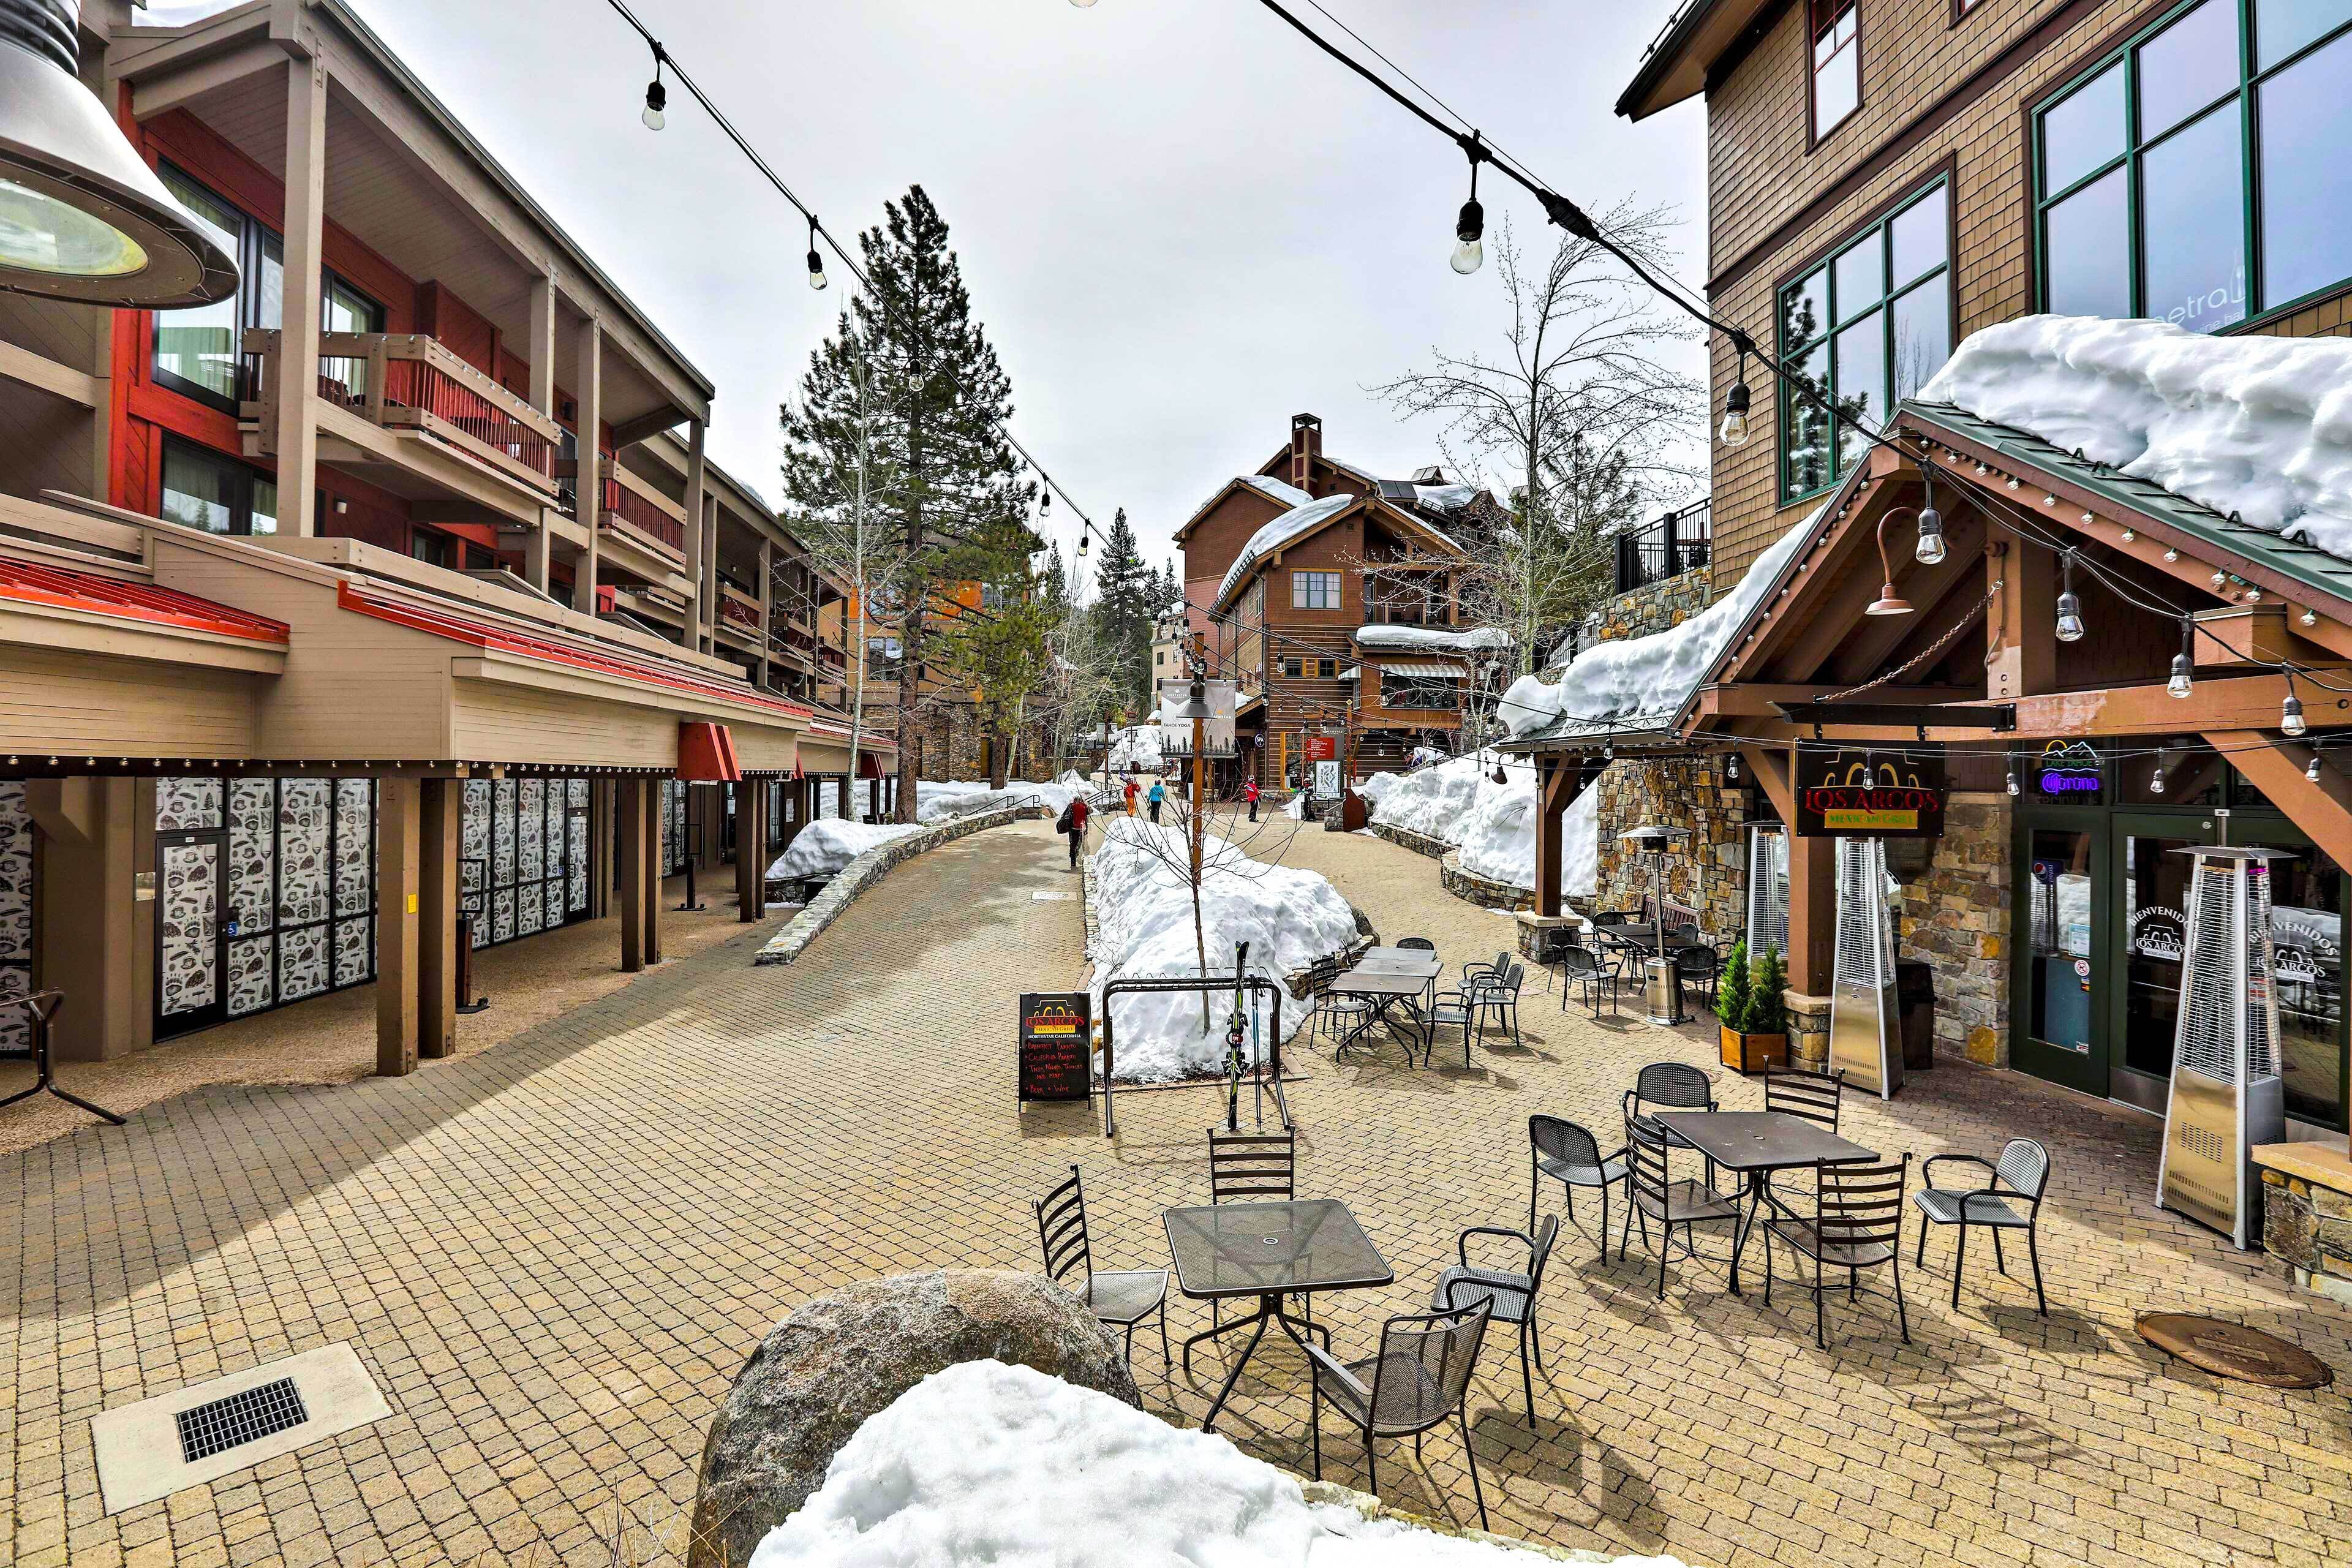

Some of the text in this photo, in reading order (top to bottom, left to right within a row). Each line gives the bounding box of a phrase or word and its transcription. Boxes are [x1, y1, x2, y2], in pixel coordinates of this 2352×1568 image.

[2154, 288, 2228, 325] etra
[2042, 772, 2099, 795] Corona
[1805, 789, 1940, 815] LOS ARCOS
[1830, 814, 1915, 824] MEXICAN GRILL
[2130, 906, 2189, 930] BIENVENIDO
[2136, 938, 2153, 949] LOS
[2280, 960, 2326, 978] ARCOS
[1025, 1017, 1085, 1028] LOS ARCOS
